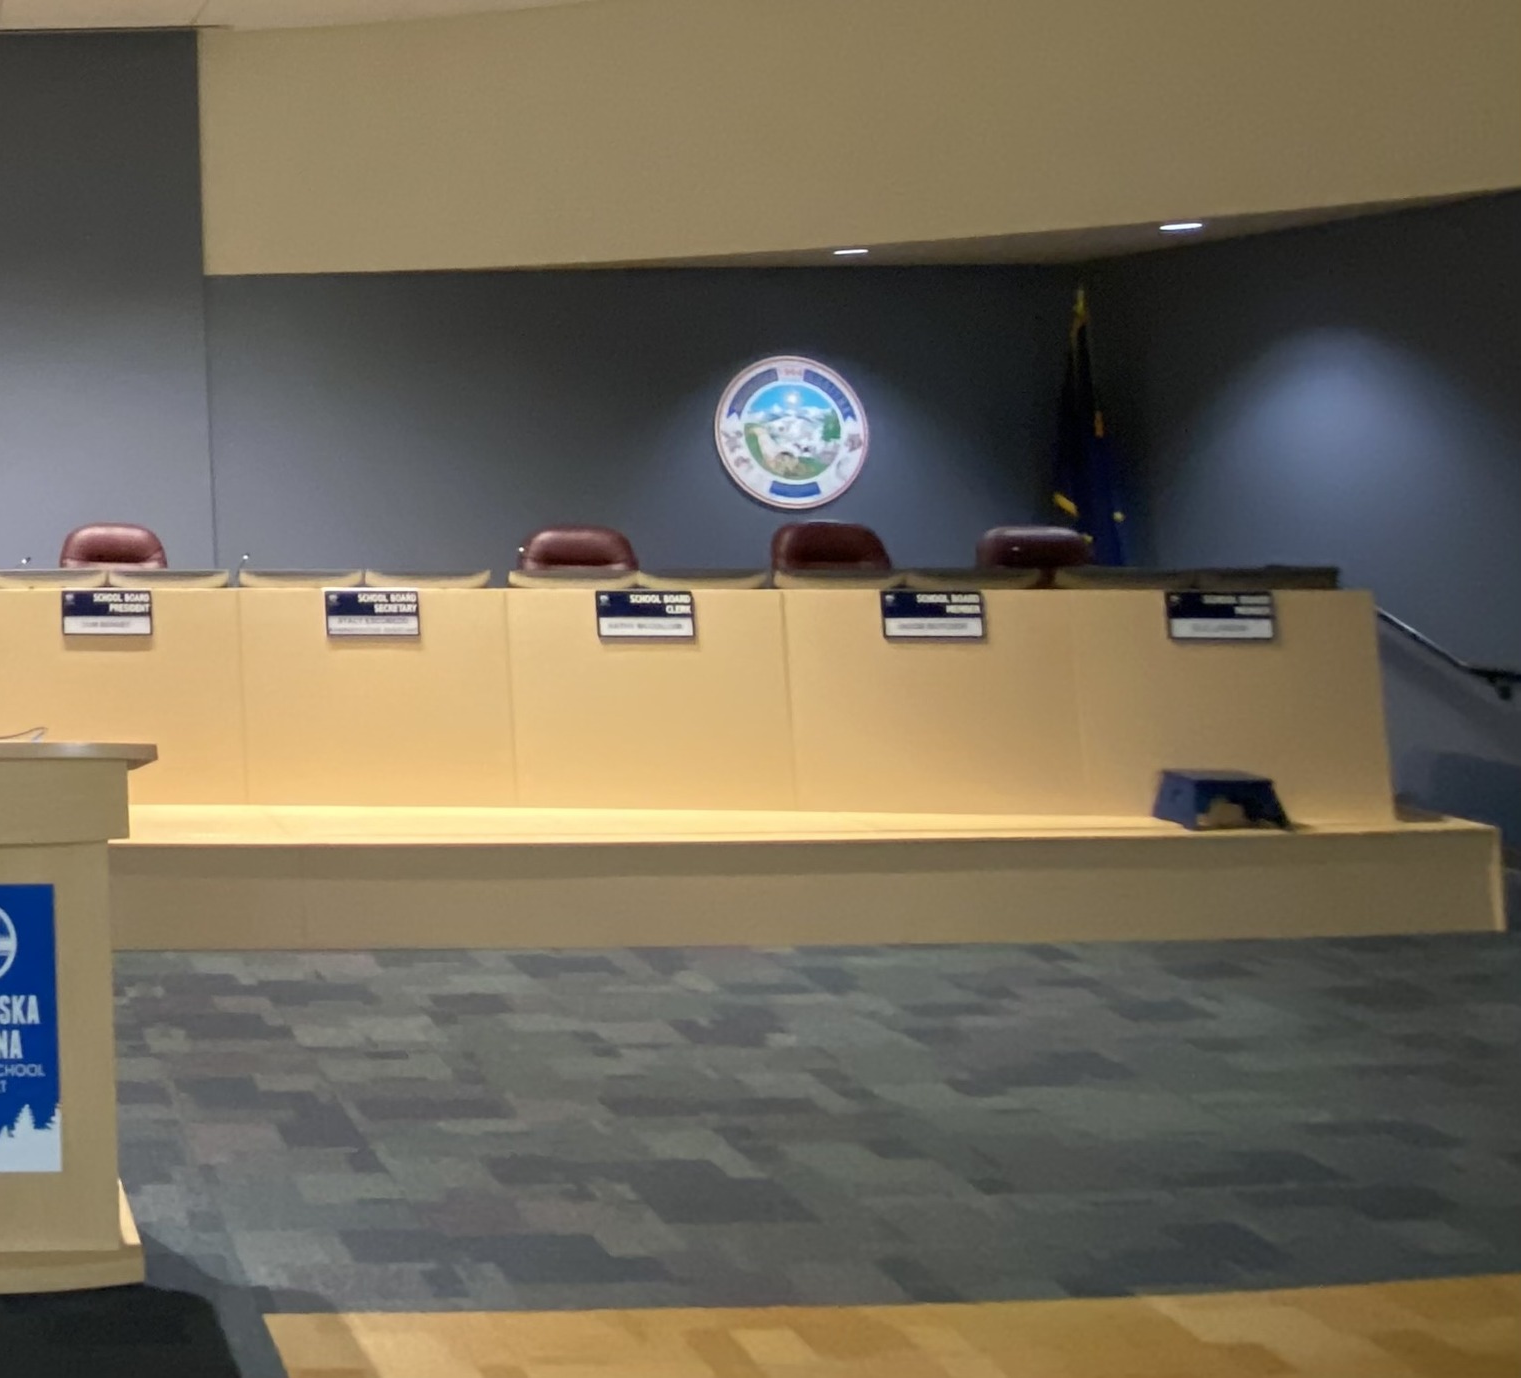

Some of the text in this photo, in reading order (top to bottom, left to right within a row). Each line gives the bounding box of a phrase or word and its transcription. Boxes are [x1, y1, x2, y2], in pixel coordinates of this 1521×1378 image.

[93, 592, 150, 602] SCHOOL BOARD
[357, 593, 417, 603] SCHOOL BOARD
[629, 594, 691, 604] SCHOOL BOARD
[109, 603, 151, 613] PRESIDENT
[373, 603, 417, 613] SECRETARY
[665, 605, 691, 614] CLERK
